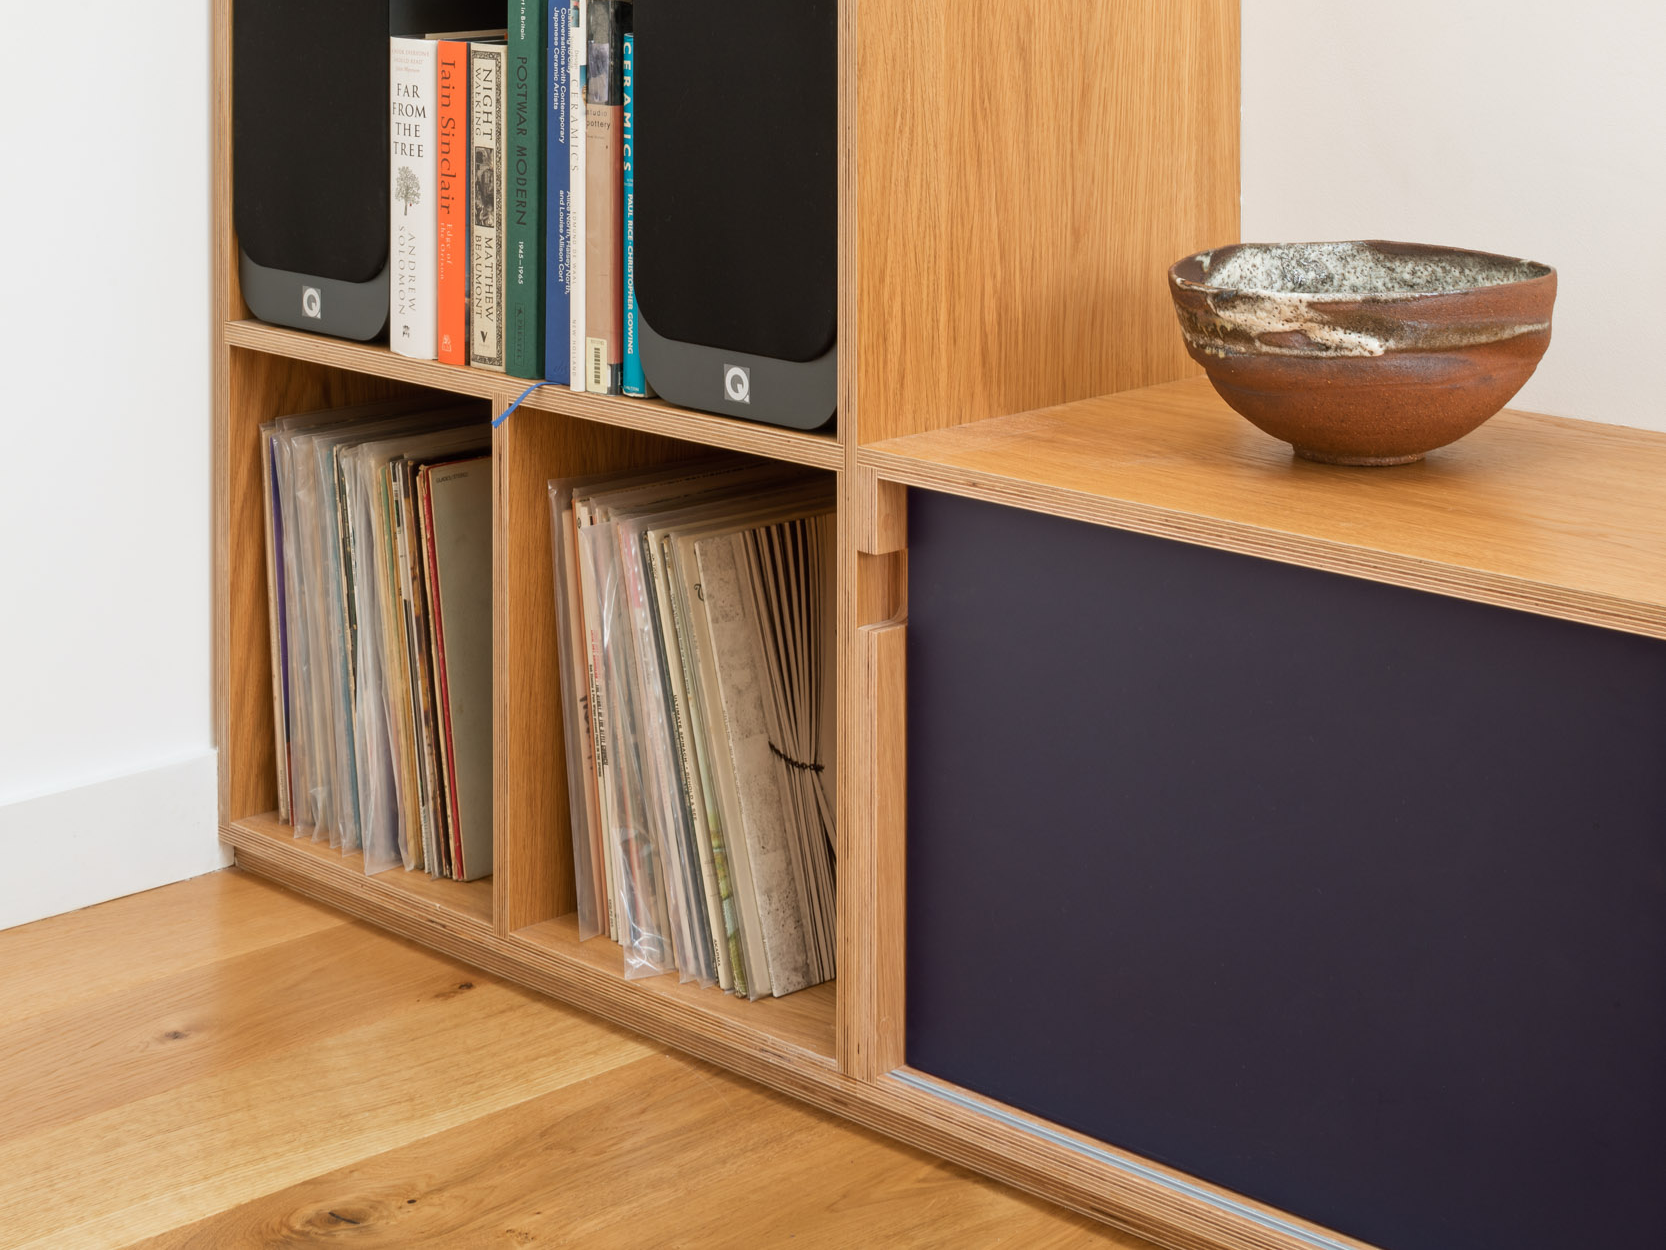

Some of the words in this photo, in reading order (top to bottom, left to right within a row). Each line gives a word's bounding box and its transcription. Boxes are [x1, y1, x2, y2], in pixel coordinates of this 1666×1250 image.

[396, 83, 420, 98] FAR
[440, 60, 456, 108] Iain
[482, 68, 493, 140] NIGHT
[516, 56, 528, 136] POSTWAR
[392, 102, 426, 118] FROM
[570, 78, 578, 172] CERAMICS
[586, 109, 608, 118] studio
[586, 120, 611, 130] pottery
[623, 42, 632, 172] CERAMICS
[394, 141, 424, 158] TREE
[396, 122, 420, 138] THE
[440, 117, 456, 215] Sinclair
[516, 145, 528, 226] MODERN
[408, 232, 416, 312] ANDREW
[446, 252, 452, 264] of
[474, 235, 482, 318] BEAUMONT
[484, 236, 494, 322] MATTHEW
[302, 288, 321, 319] Q
[725, 366, 750, 404] Q
[674, 694, 682, 729] ULTIMATE
